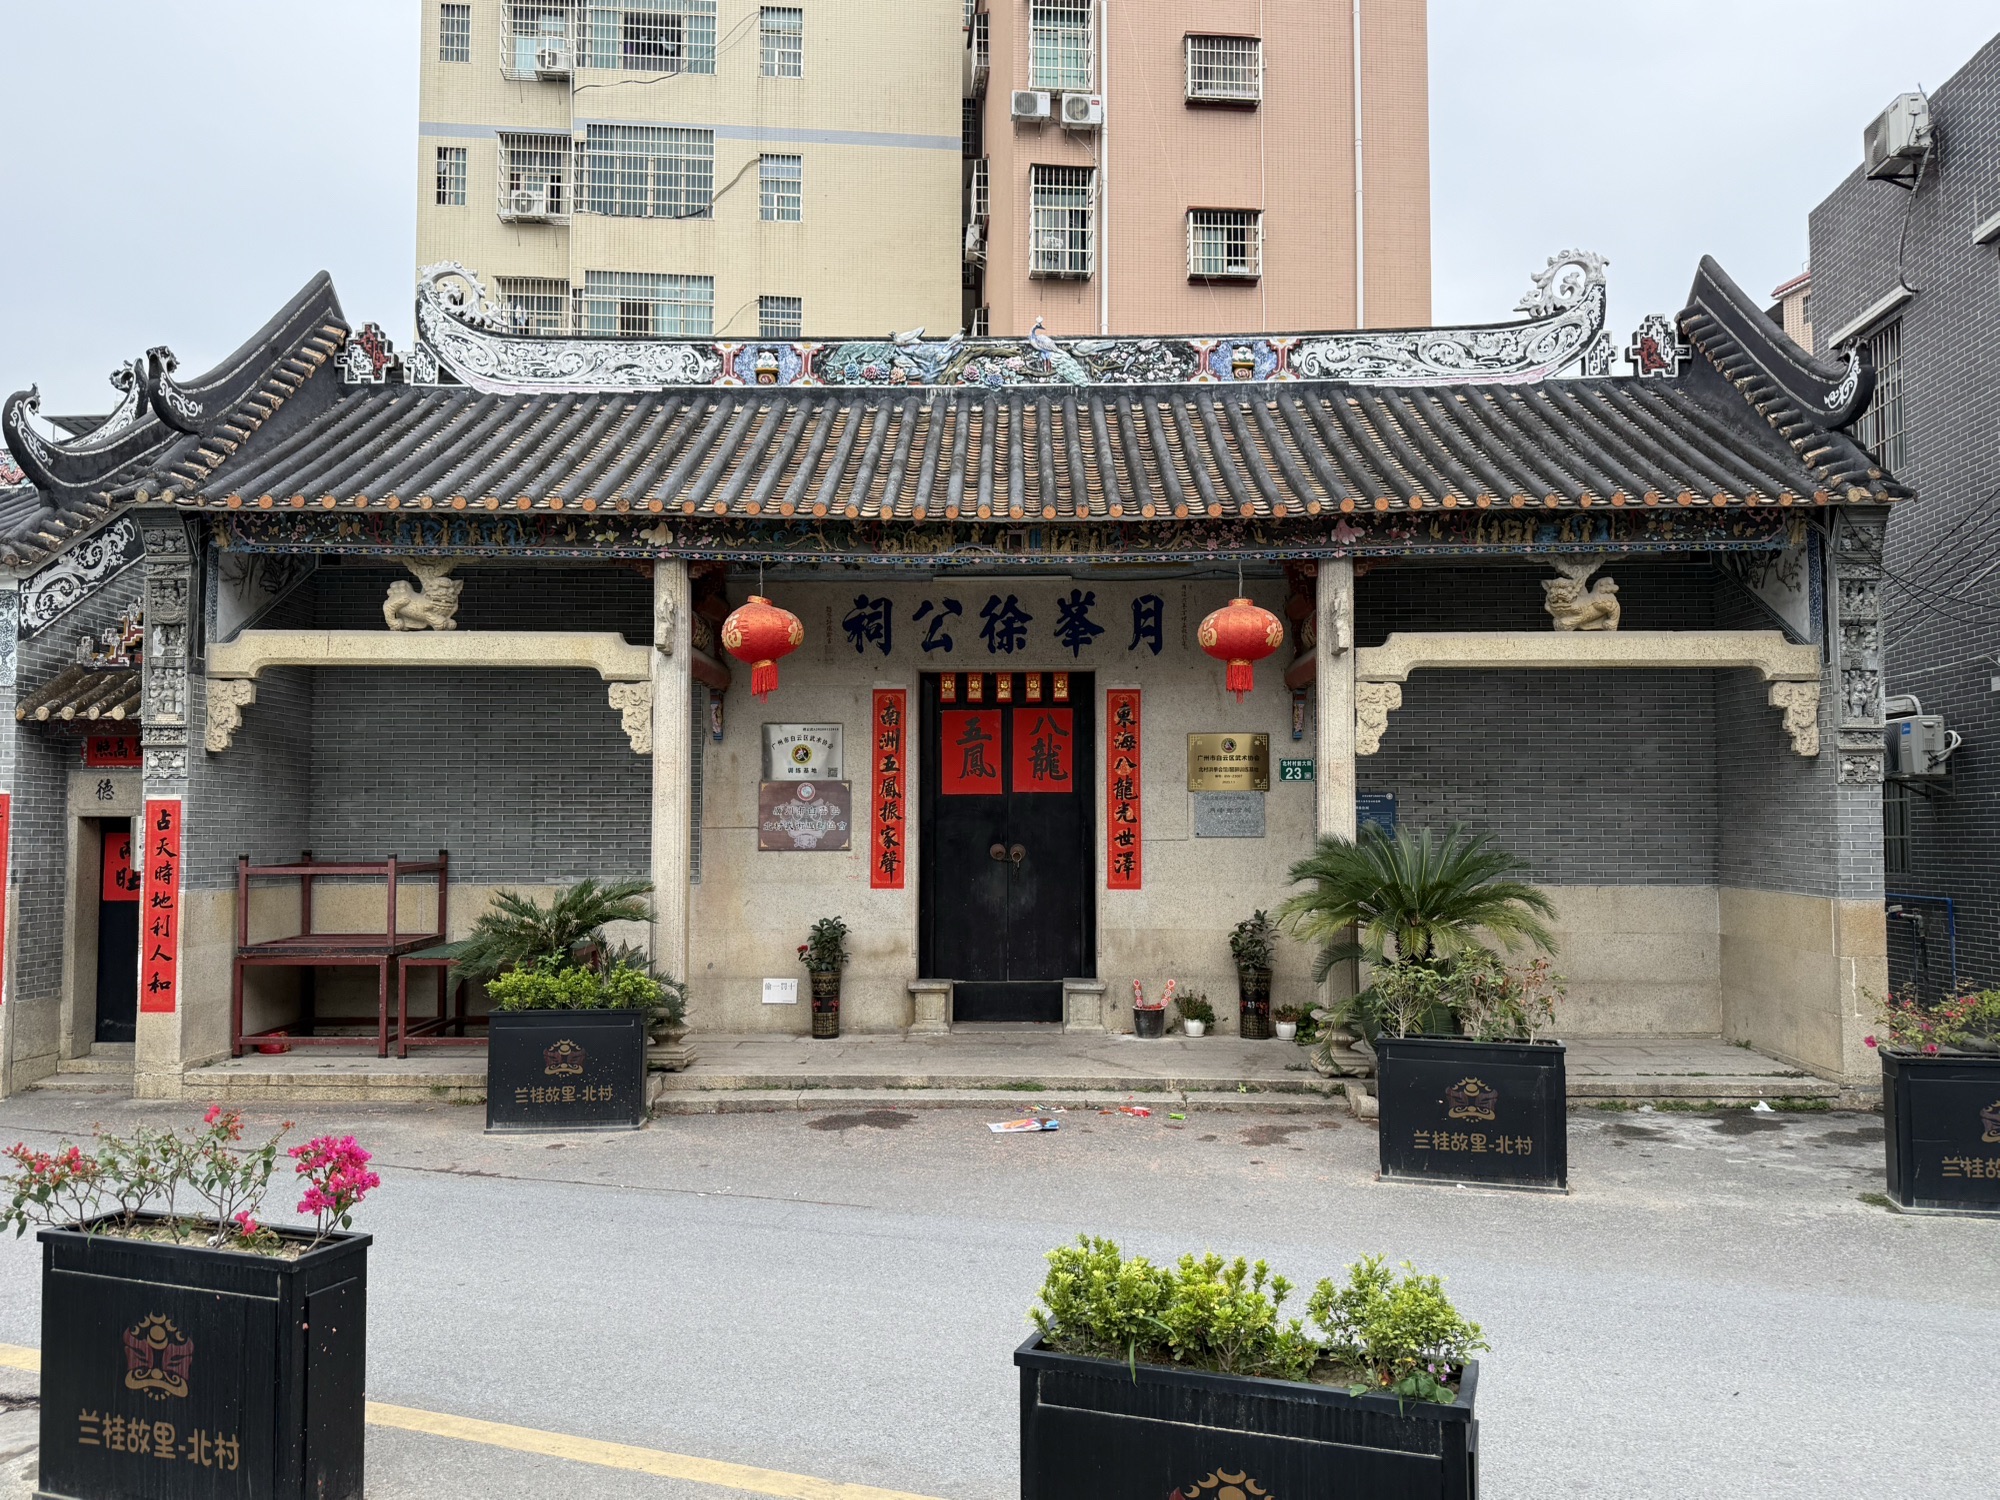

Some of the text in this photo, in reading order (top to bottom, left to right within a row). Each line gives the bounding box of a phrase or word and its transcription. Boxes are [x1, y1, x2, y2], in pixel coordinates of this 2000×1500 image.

[771, 734, 834, 750] 广州市白云区武术协会
[956, 716, 997, 781] 五鳳
[1028, 711, 1070, 781] 八龍
[1197, 754, 1260, 762] 广州市白云区武术协会
[1285, 767, 1302, 780] 23
[147, 808, 178, 994] 占天時地利人和
[514, 1084, 613, 1104] 兰桂故里-北村
[1413, 1130, 1533, 1156] 兰桂故里-北村
[78, 1408, 241, 1471] 兰桂故里-北村
